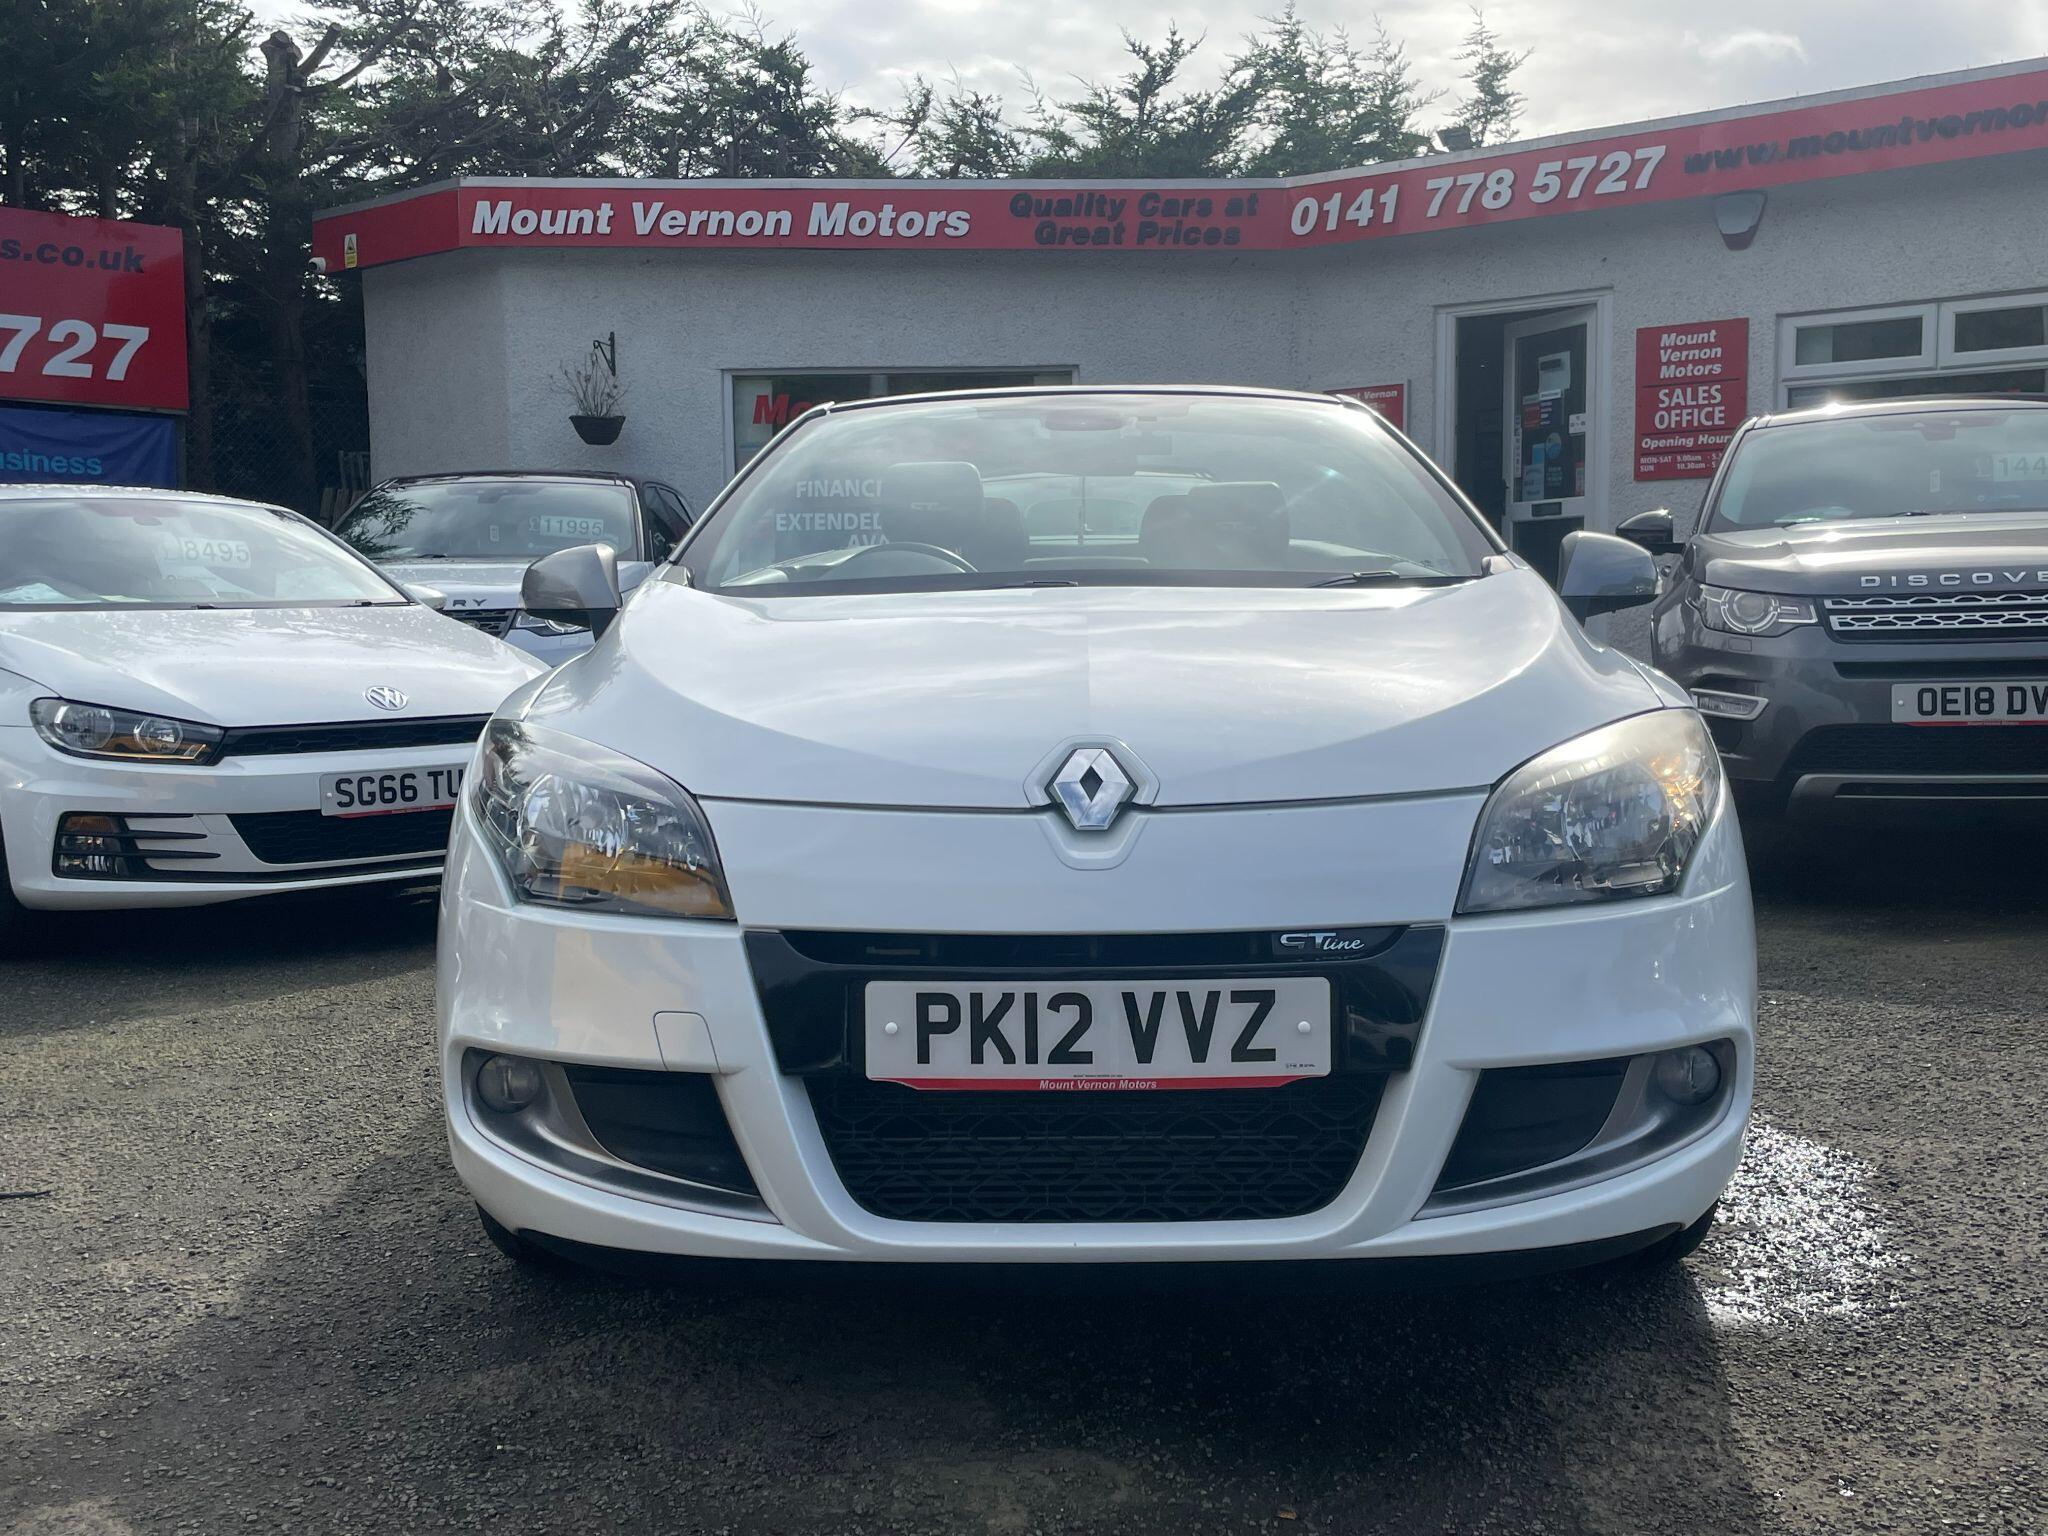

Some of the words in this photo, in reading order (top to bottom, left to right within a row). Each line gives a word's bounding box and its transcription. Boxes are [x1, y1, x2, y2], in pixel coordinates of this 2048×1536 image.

[1291, 184, 1399, 236] 0141
[1425, 168, 1515, 218] 778
[1528, 145, 1667, 204] 5727
[472, 200, 613, 236] Mount
[632, 201, 793, 237] Vernon
[806, 202, 971, 237] Motors
[1009, 192, 1127, 222] Quality
[1138, 193, 1213, 217] Cars
[1224, 193, 1259, 217] at
[1034, 220, 1126, 245] Great
[1136, 220, 1241, 245] Prices
[0, 313, 150, 382] 727
[1660, 329, 1717, 347] Mount
[1660, 346, 1722, 362] Vernon
[1660, 363, 1722, 379] Motors
[1658, 384, 1722, 408] SALES
[1654, 406, 1726, 430] OFFICE
[1641, 436, 1694, 450] Opening
[1697, 433, 1734, 445] Hour
[1860, 570, 2048, 588] DISCOVE
[1917, 686, 1995, 716] OE18
[335, 773, 418, 808] SG66
[915, 992, 1093, 1064] PK12
[1121, 989, 1276, 1064] VVZ
[1039, 1080, 1075, 1090] Mount
[1077, 1080, 1116, 1090] Vernon
[1119, 1080, 1158, 1090] Motors
